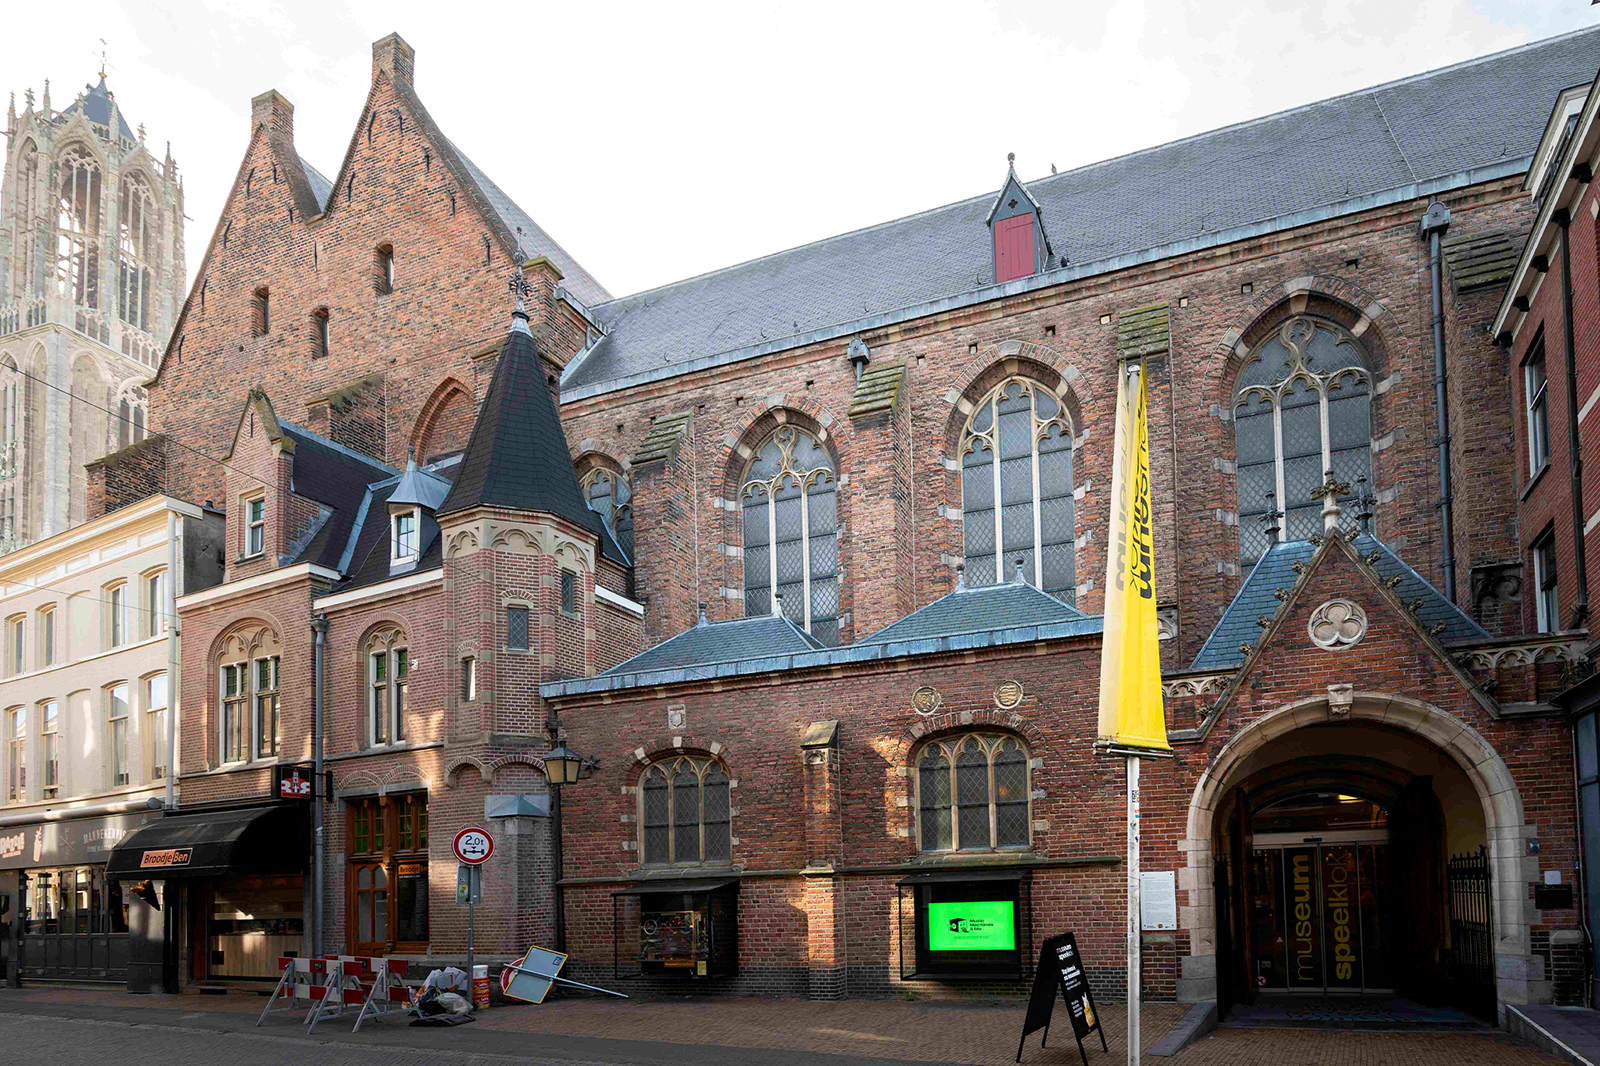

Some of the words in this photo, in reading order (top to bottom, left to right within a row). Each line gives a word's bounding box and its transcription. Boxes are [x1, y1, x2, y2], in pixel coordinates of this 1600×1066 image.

[144, 852, 173, 865] Broodje
[174, 851, 188, 862] Ben
[1293, 855, 1314, 980] museum
[1327, 850, 1356, 980] speelklok
